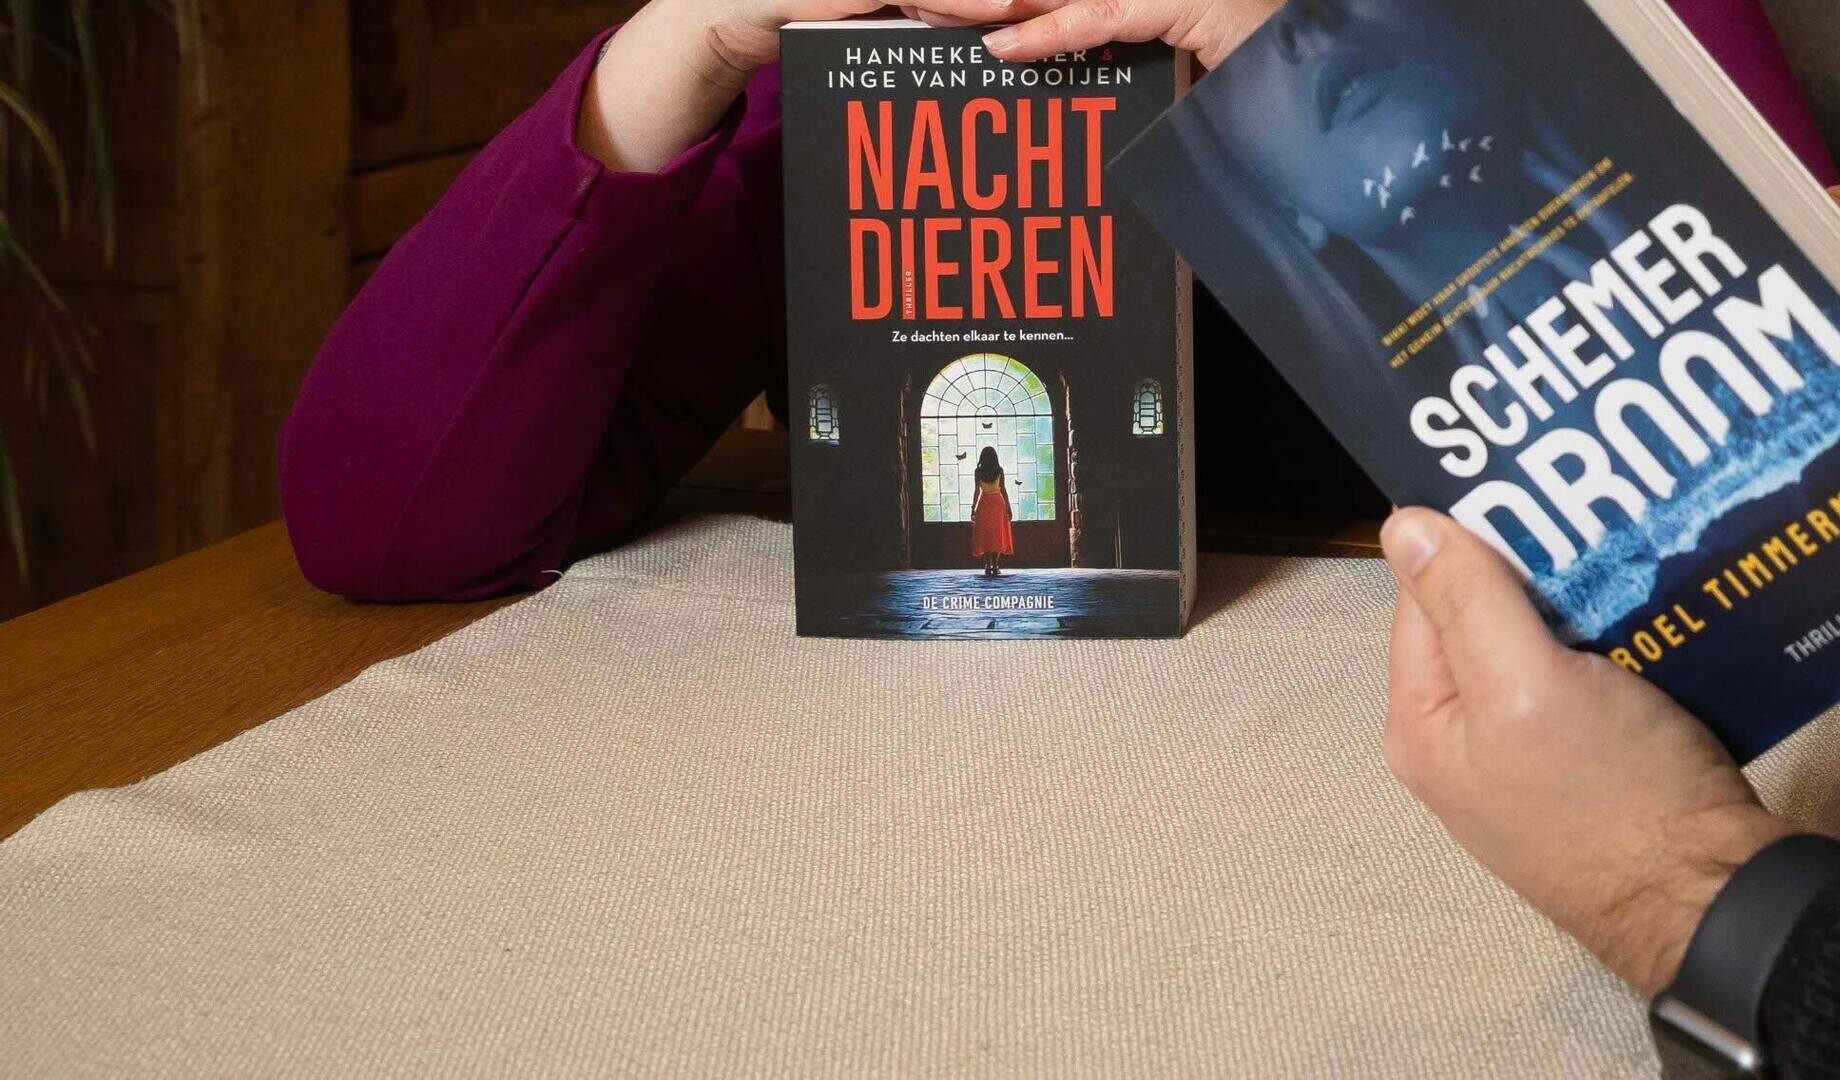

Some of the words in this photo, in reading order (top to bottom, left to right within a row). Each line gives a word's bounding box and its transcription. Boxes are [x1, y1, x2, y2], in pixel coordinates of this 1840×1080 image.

[828, 71, 897, 89] INGE
[911, 70, 967, 88] VAN
[982, 67, 1132, 87] PROOIJEN
[845, 46, 983, 66] HANNEKE
[1102, 48, 1113, 61] &
[847, 96, 1116, 210] NACHT
[849, 215, 1115, 320] DIEREN
[892, 331, 909, 342] Ze
[911, 330, 960, 342] dachten
[963, 330, 1000, 342] elkaar
[1004, 331, 1017, 341] te
[1019, 330, 1074, 341] kennen...
[1409, 203, 1748, 478] SCHEMER
[923, 597, 938, 609] DE
[942, 596, 980, 610] CRIME
[984, 595, 1055, 610] COMPAGNIE
[1609, 603, 1706, 675] ROEL
